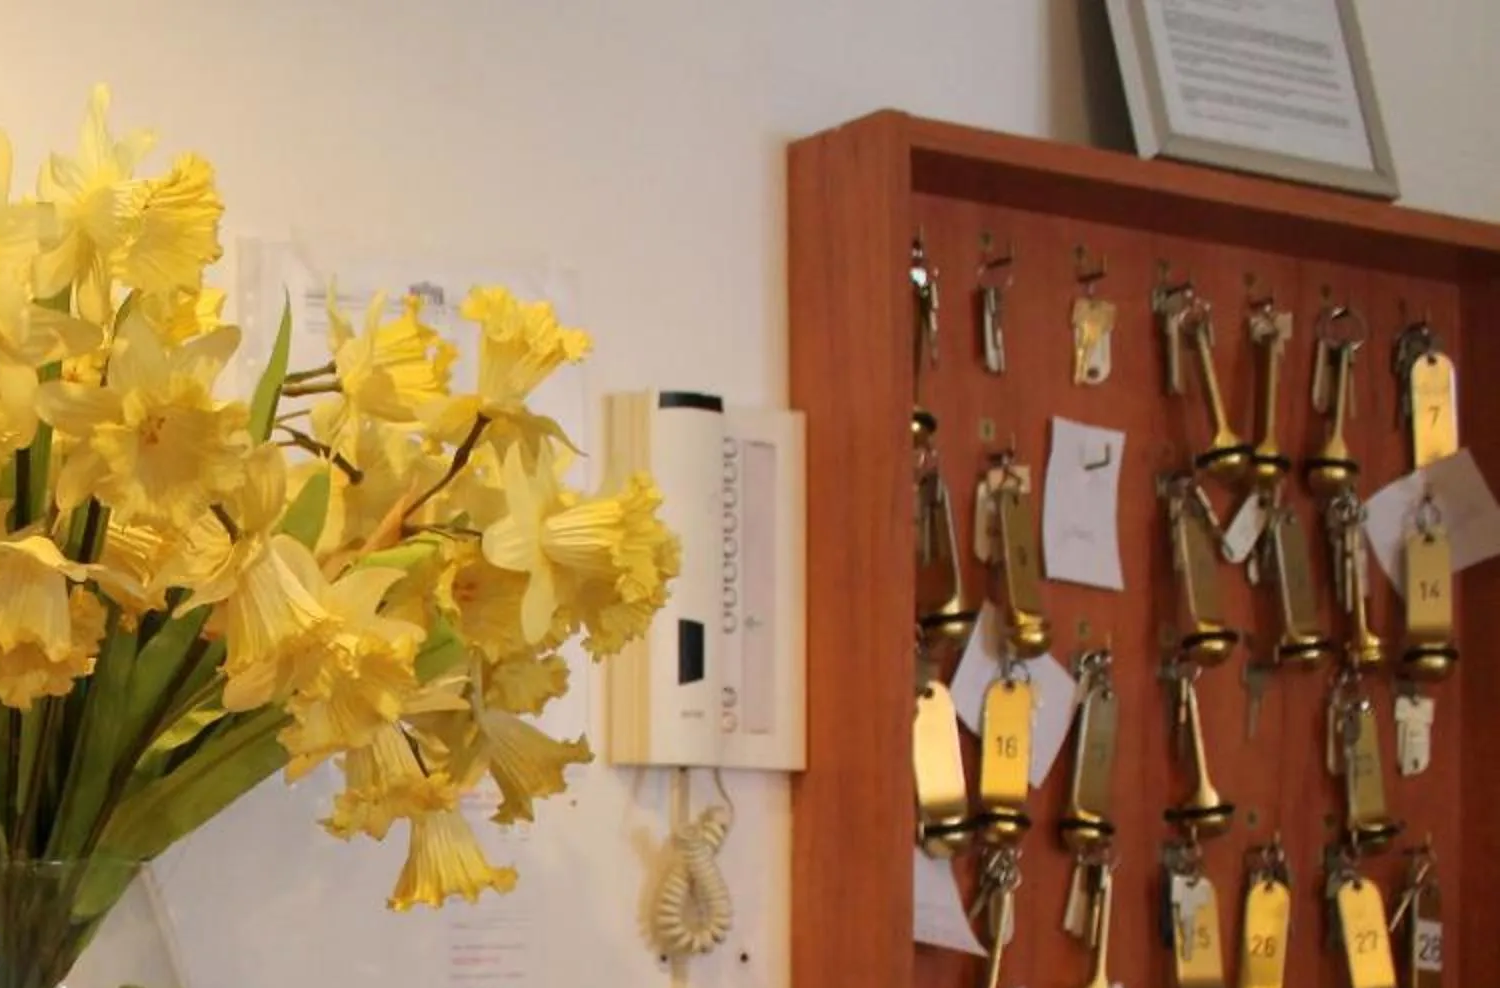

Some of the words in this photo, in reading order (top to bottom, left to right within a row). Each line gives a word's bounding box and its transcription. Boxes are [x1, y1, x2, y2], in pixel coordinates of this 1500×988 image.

[1427, 406, 1441, 432] 7
[995, 736, 1018, 759] 16
[1250, 936, 1276, 958] 26
[1354, 931, 1379, 954] 27
